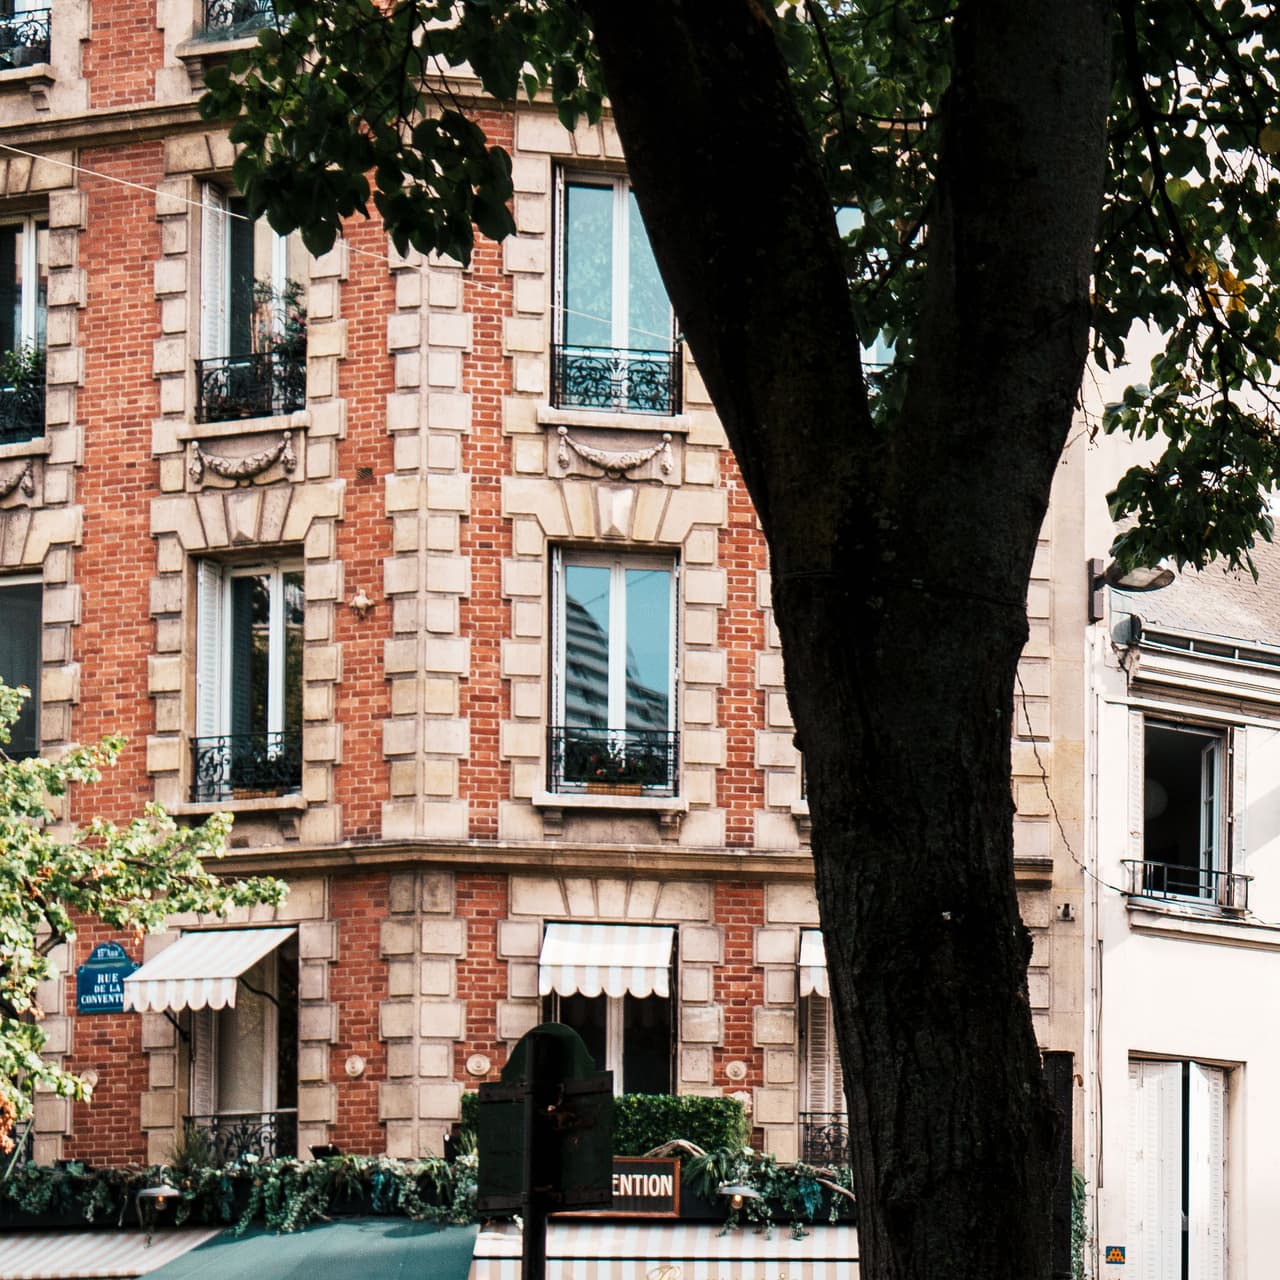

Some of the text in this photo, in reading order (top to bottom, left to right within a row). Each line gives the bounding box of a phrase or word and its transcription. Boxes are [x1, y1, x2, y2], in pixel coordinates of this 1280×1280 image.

[97, 972, 119, 984] RUE
[94, 983, 121, 993] DE LA
[81, 993, 124, 1005] CONVENTI
[611, 1173, 673, 1197] ENTION
